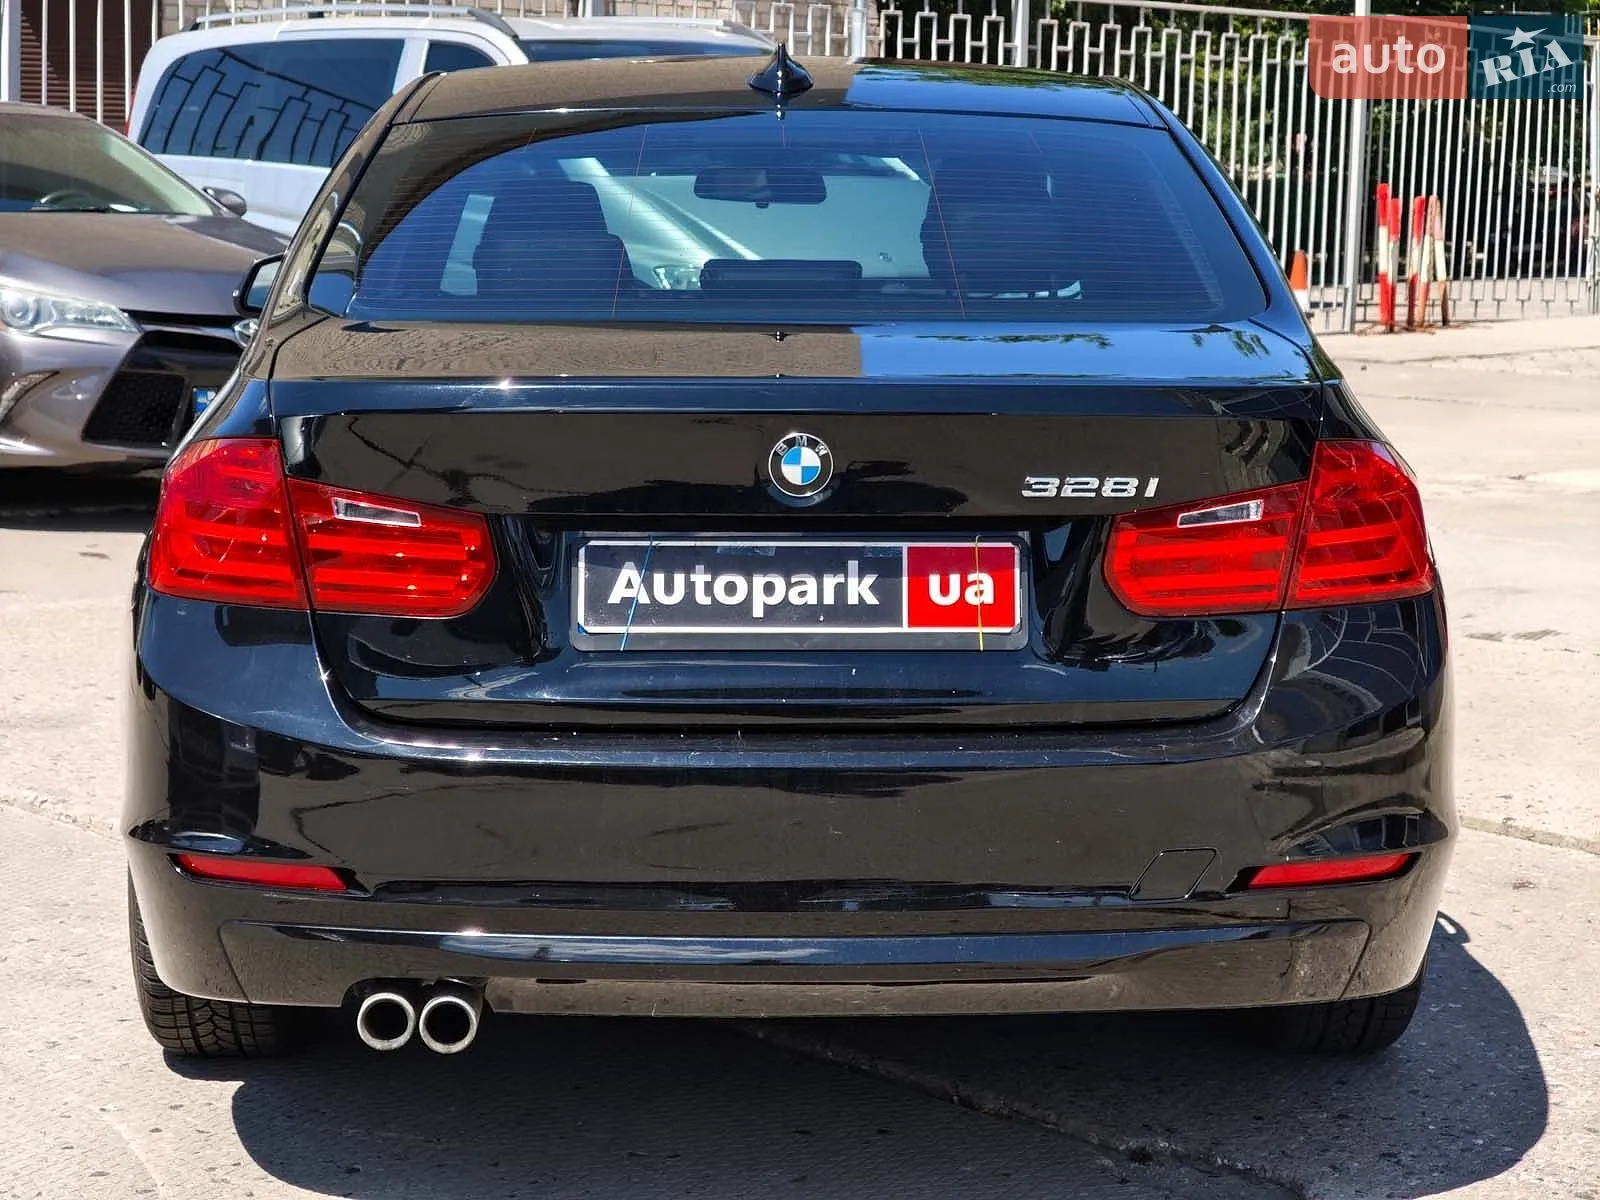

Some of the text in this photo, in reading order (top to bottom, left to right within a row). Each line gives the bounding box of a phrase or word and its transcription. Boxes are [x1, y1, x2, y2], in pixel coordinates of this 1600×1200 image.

[775, 434, 829, 457] BMW
[607, 559, 995, 618] Autopark ua
